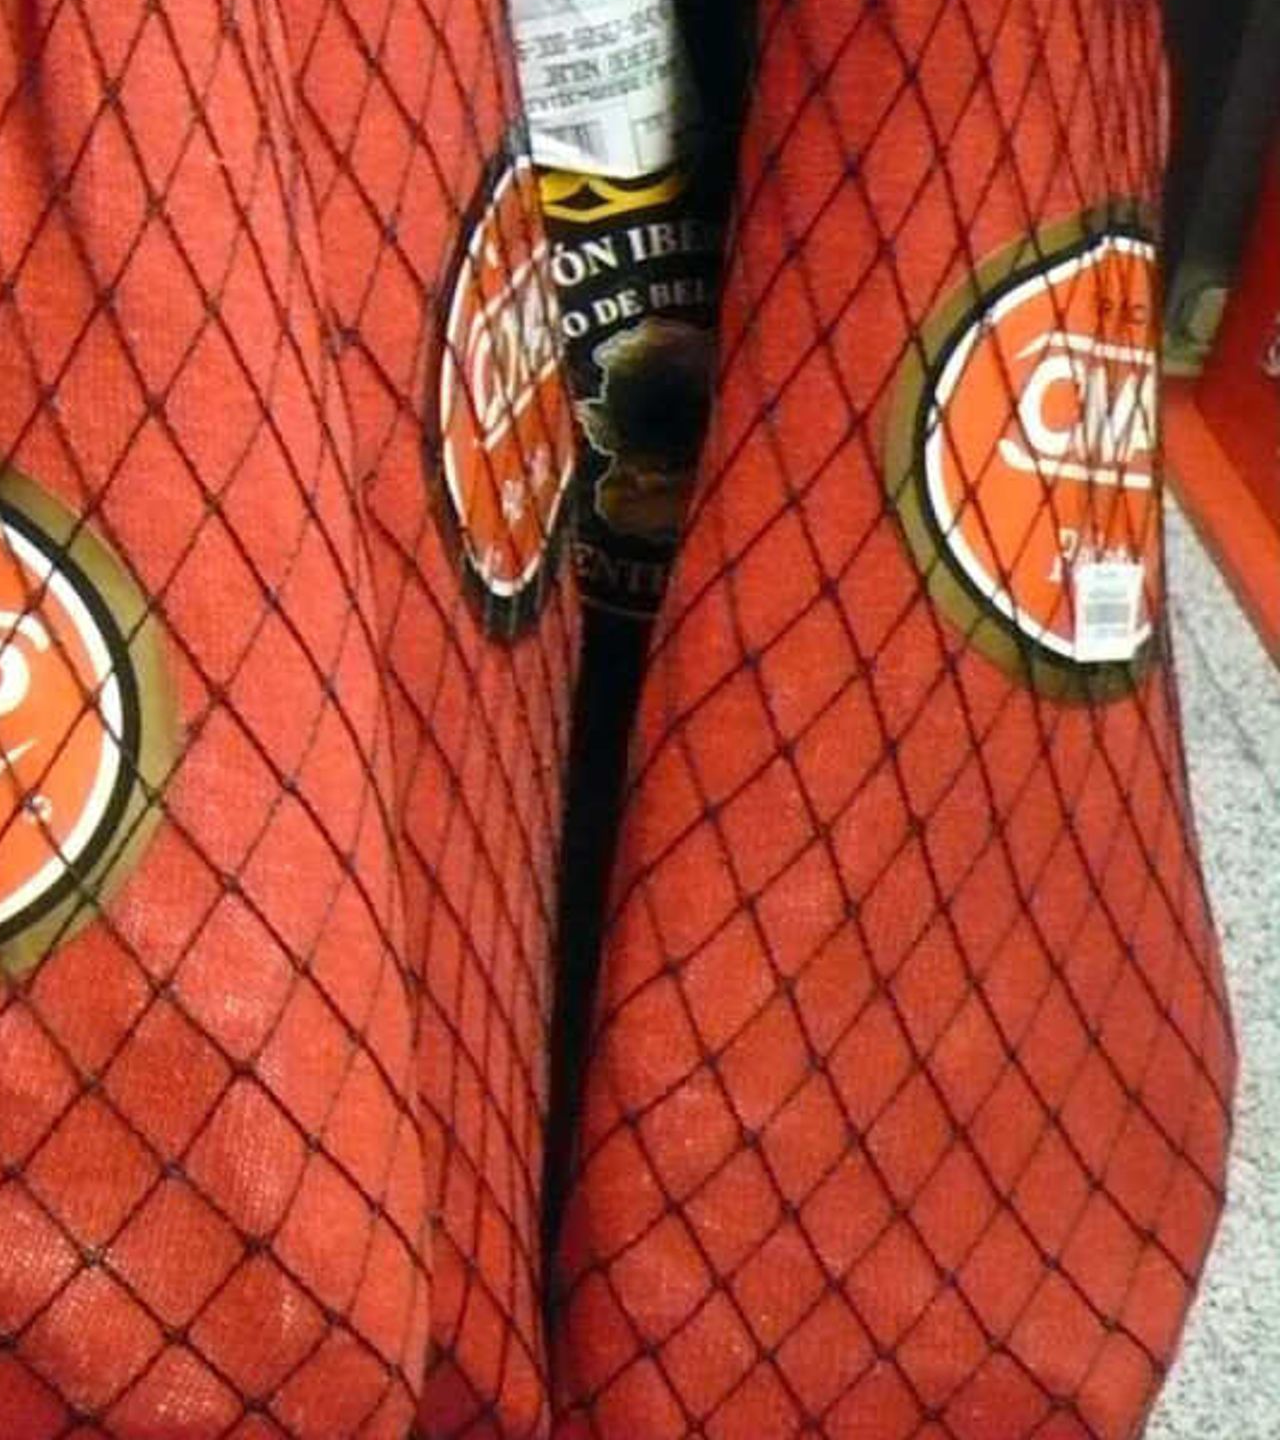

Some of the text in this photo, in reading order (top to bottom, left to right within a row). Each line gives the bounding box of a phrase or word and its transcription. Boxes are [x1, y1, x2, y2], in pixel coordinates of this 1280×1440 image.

[551, 236, 618, 287] ÓN
[562, 311, 589, 338] O
[592, 289, 644, 326] DE
